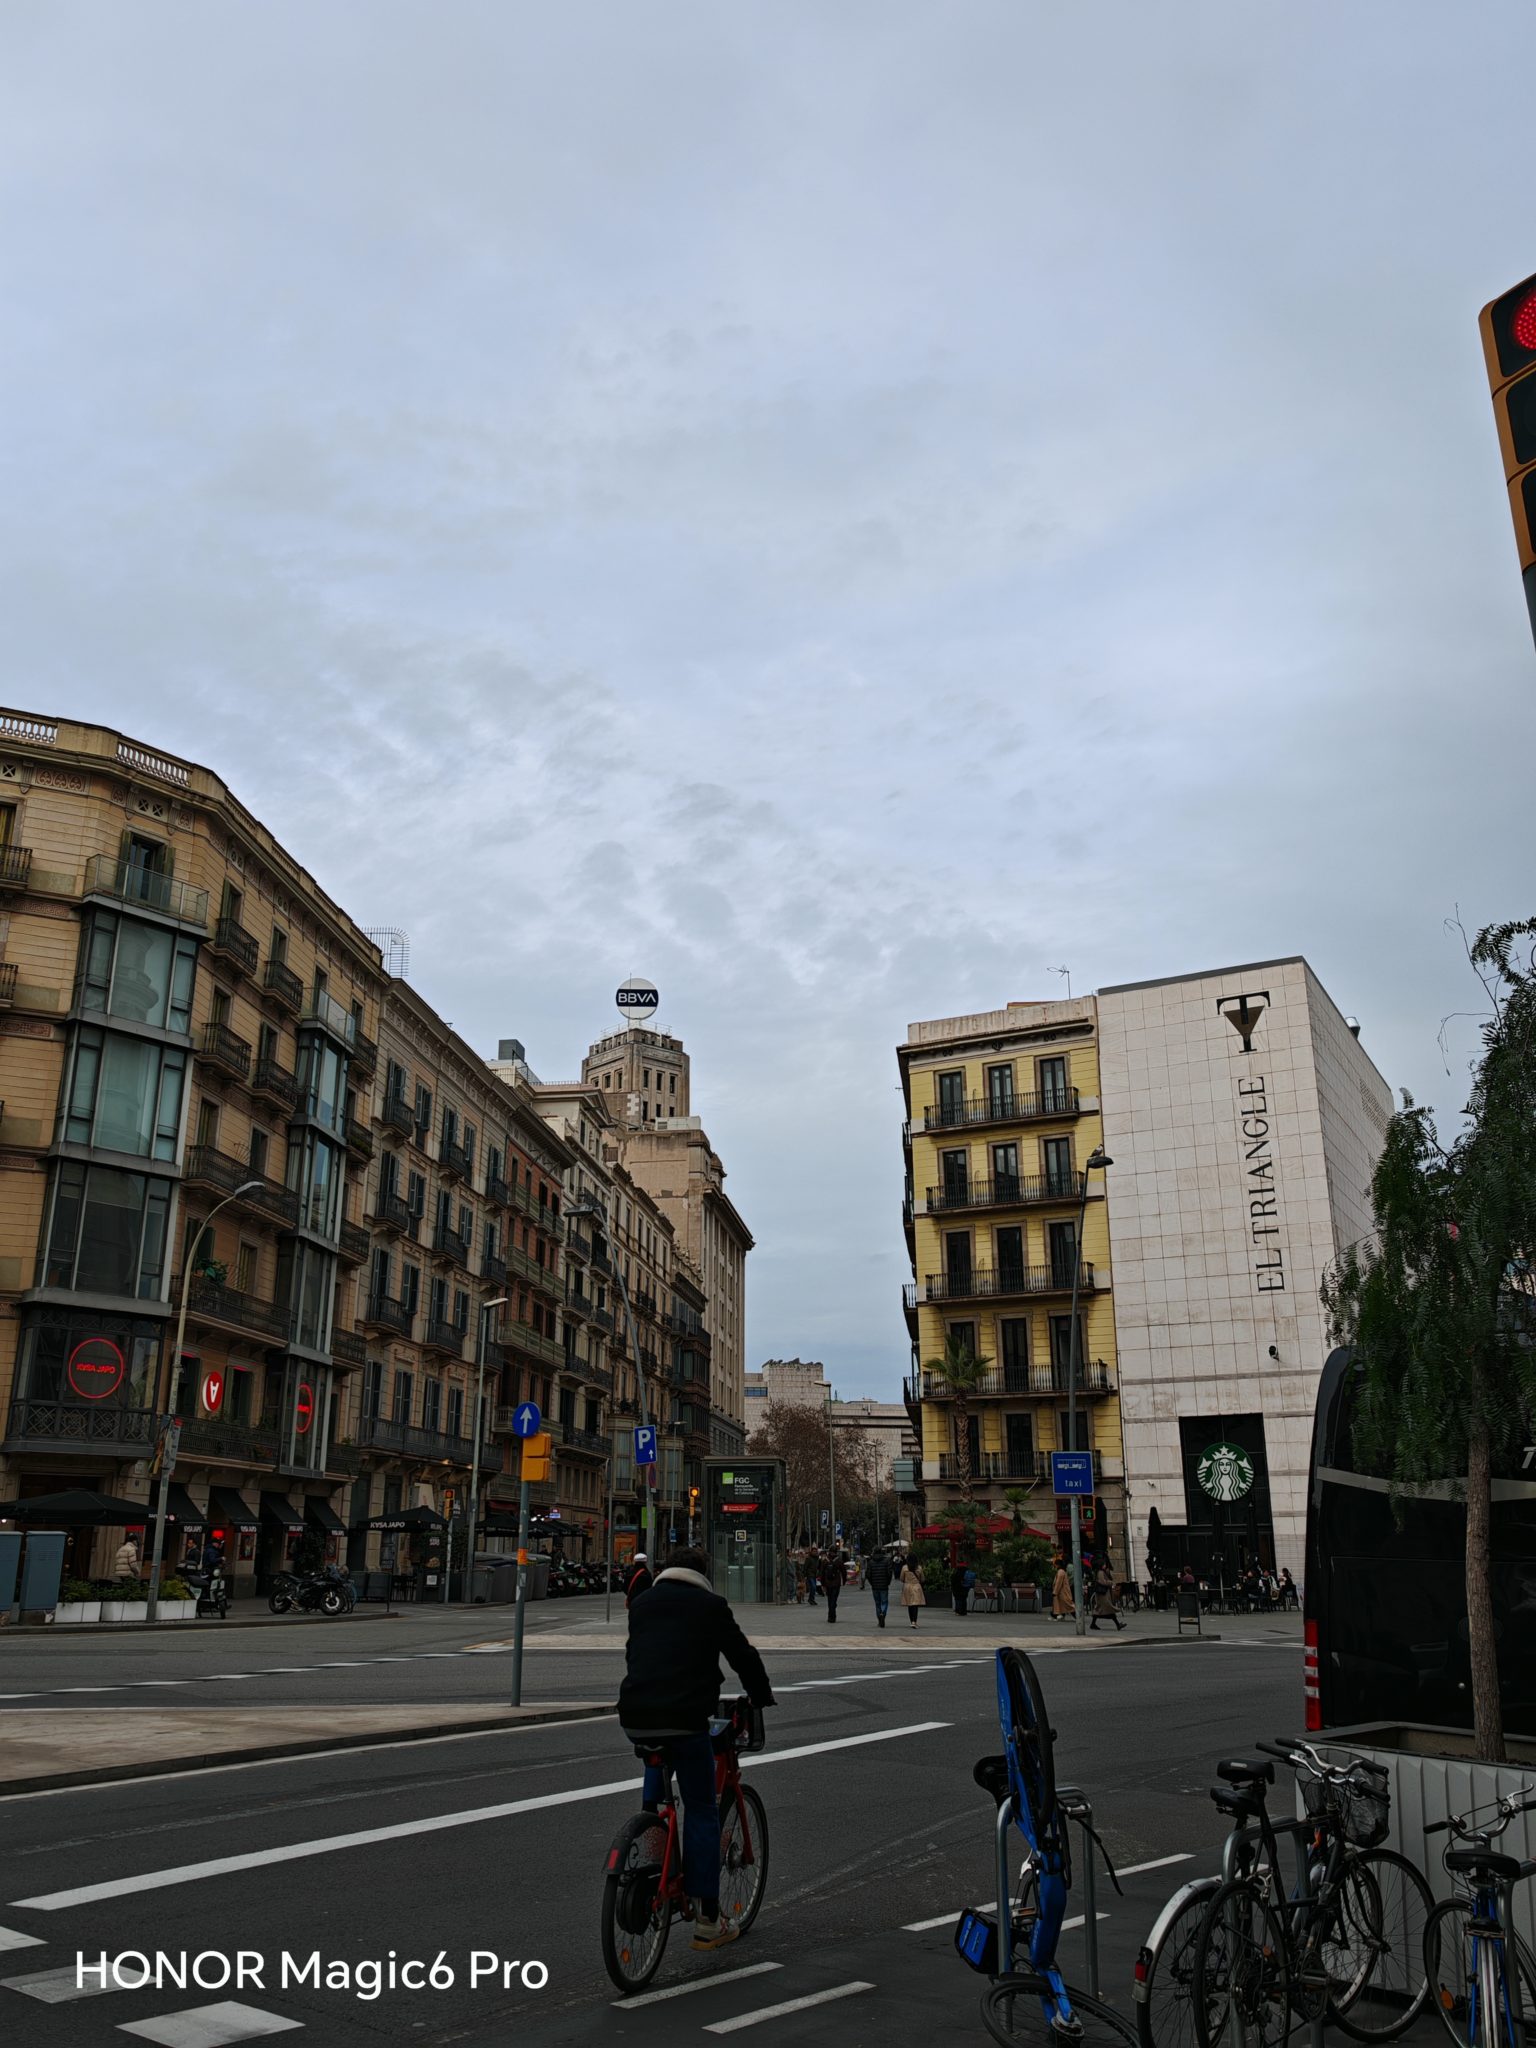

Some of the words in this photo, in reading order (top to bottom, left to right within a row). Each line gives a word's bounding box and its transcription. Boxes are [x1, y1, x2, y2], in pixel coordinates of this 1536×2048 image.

[618, 992, 656, 1003] BBVA
[1238, 1076, 1280, 1244] TRIANGLE
[1255, 1248, 1286, 1292] EL
[638, 1429, 651, 1450] P
[1065, 1479, 1082, 1488] taxi
